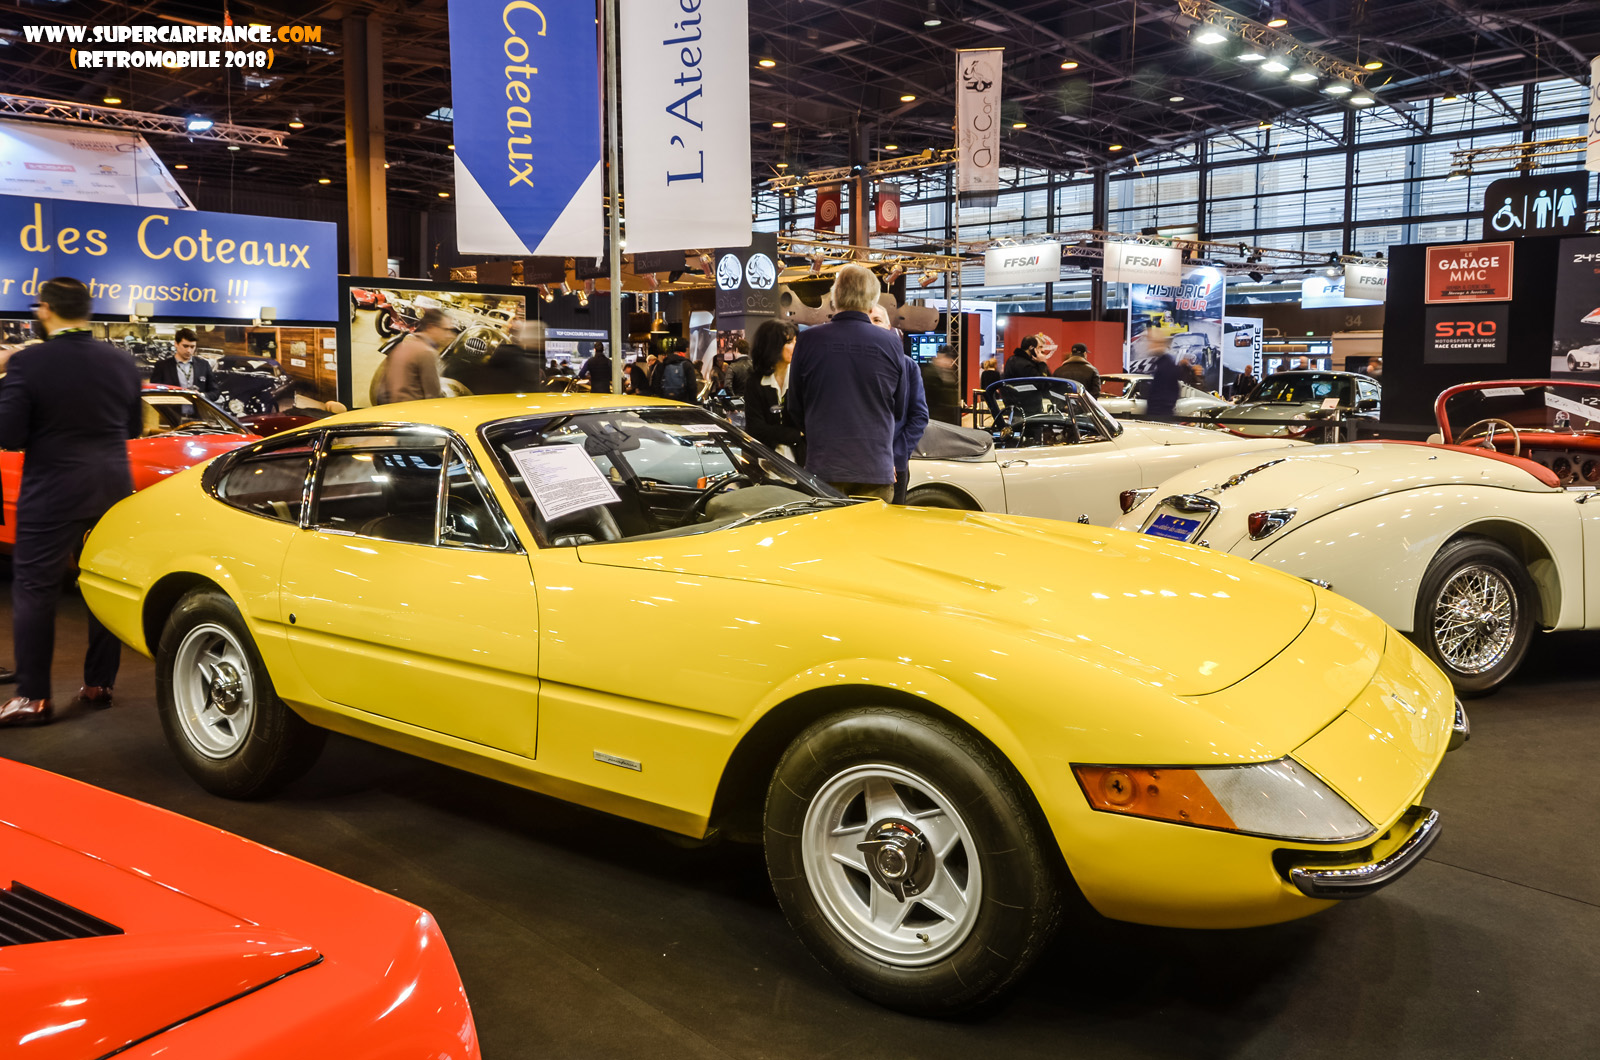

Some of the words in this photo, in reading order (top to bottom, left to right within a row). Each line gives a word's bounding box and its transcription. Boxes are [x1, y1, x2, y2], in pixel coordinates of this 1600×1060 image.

[502, 0, 547, 188] Coteaux
[19, 202, 109, 256] des
[137, 214, 311, 270] Coteaux
[1004, 256, 1037, 268] FFSA
[1125, 255, 1159, 268] FFSA
[1438, 256, 1500, 271] GARAGE
[1449, 269, 1487, 282] MMC
[128, 282, 219, 309] passion
[227, 279, 249, 305] !!!
[1175, 298, 1208, 312] TOUR
[1345, 314, 1363, 327] 34
[1435, 320, 1497, 337] SRO
[1253, 327, 1262, 381] ONTAGNE
